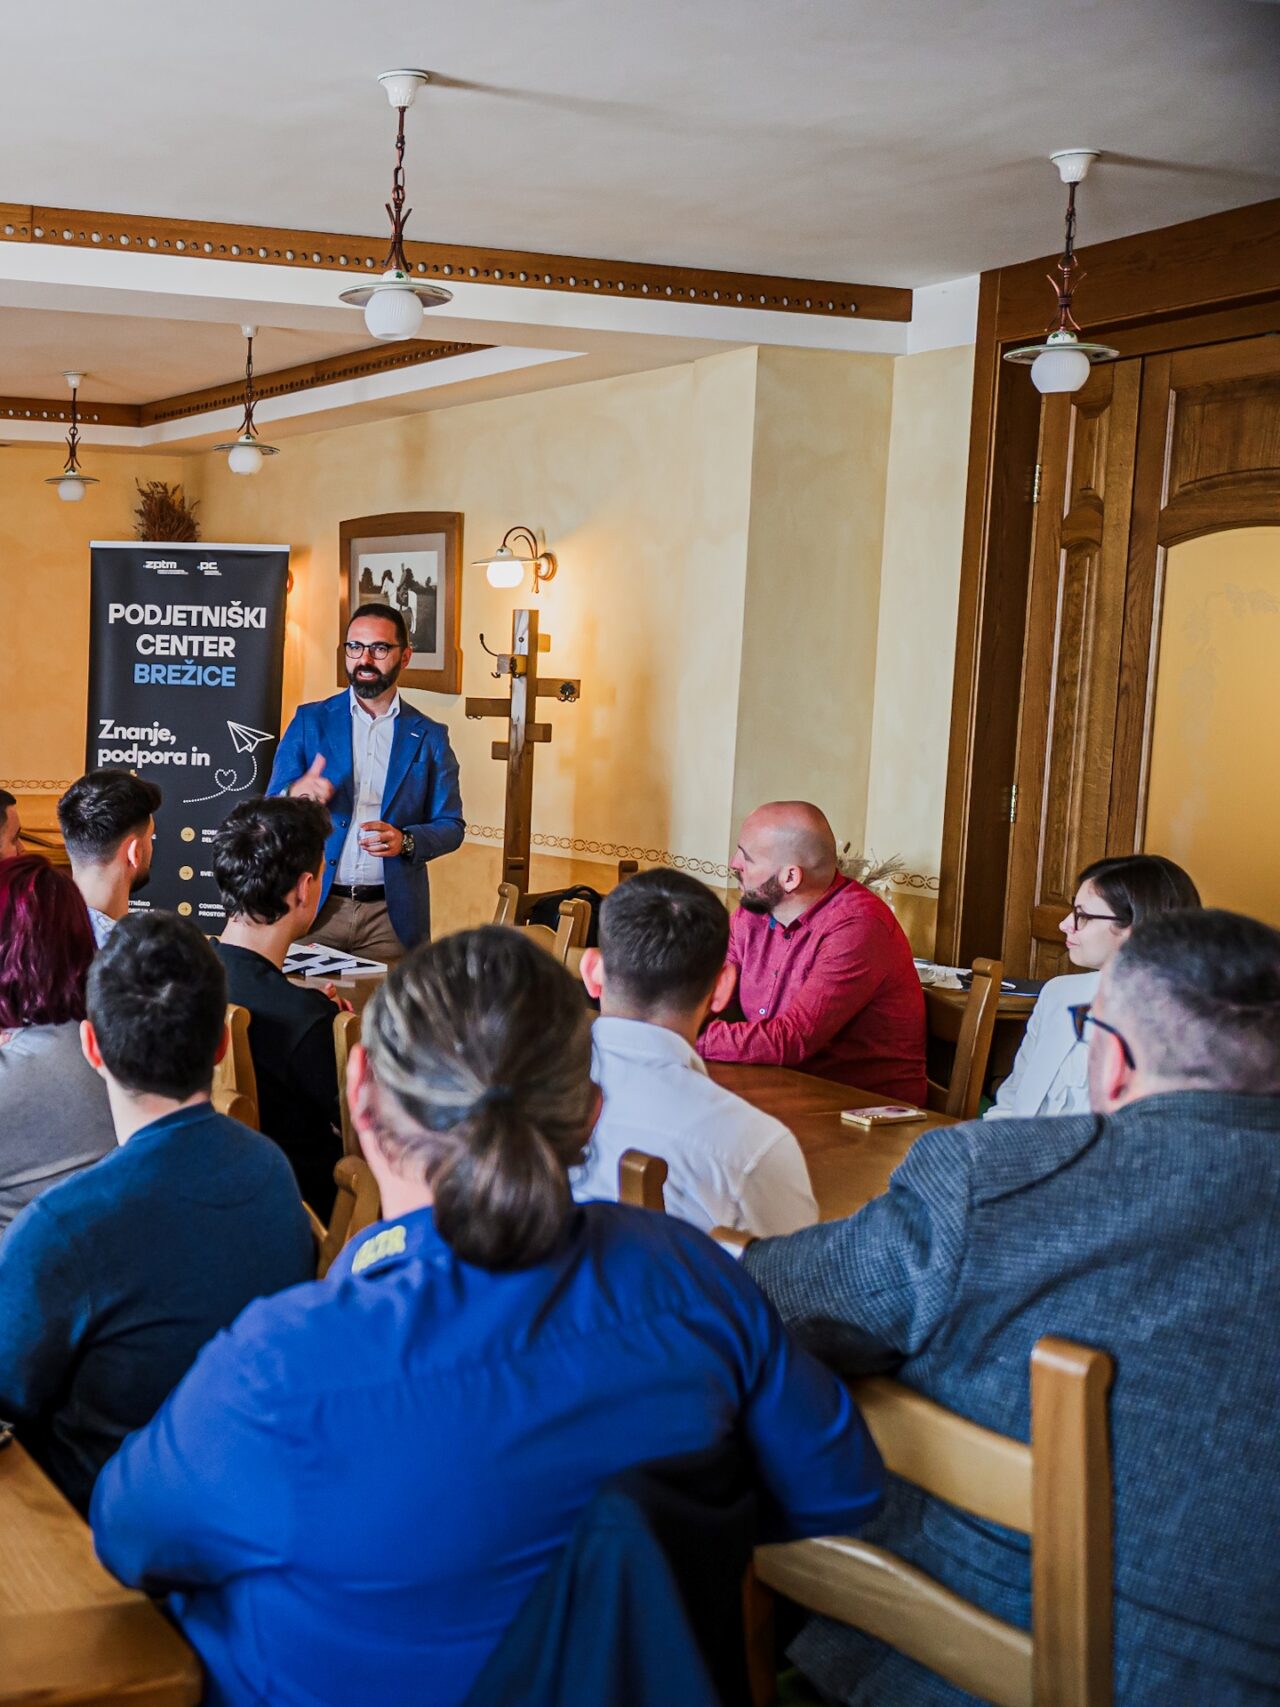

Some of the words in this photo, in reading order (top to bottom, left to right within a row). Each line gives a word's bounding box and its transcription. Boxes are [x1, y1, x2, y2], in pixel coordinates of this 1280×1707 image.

[145, 560, 177, 569] zptm
[200, 561, 218, 570] pc
[108, 600, 267, 629] PODJETNIŠKI
[136, 633, 236, 658] CENTER
[134, 659, 236, 687] BREŽICE
[98, 719, 177, 747] Znanje,
[98, 743, 187, 769] podpora
[191, 746, 211, 766] in
